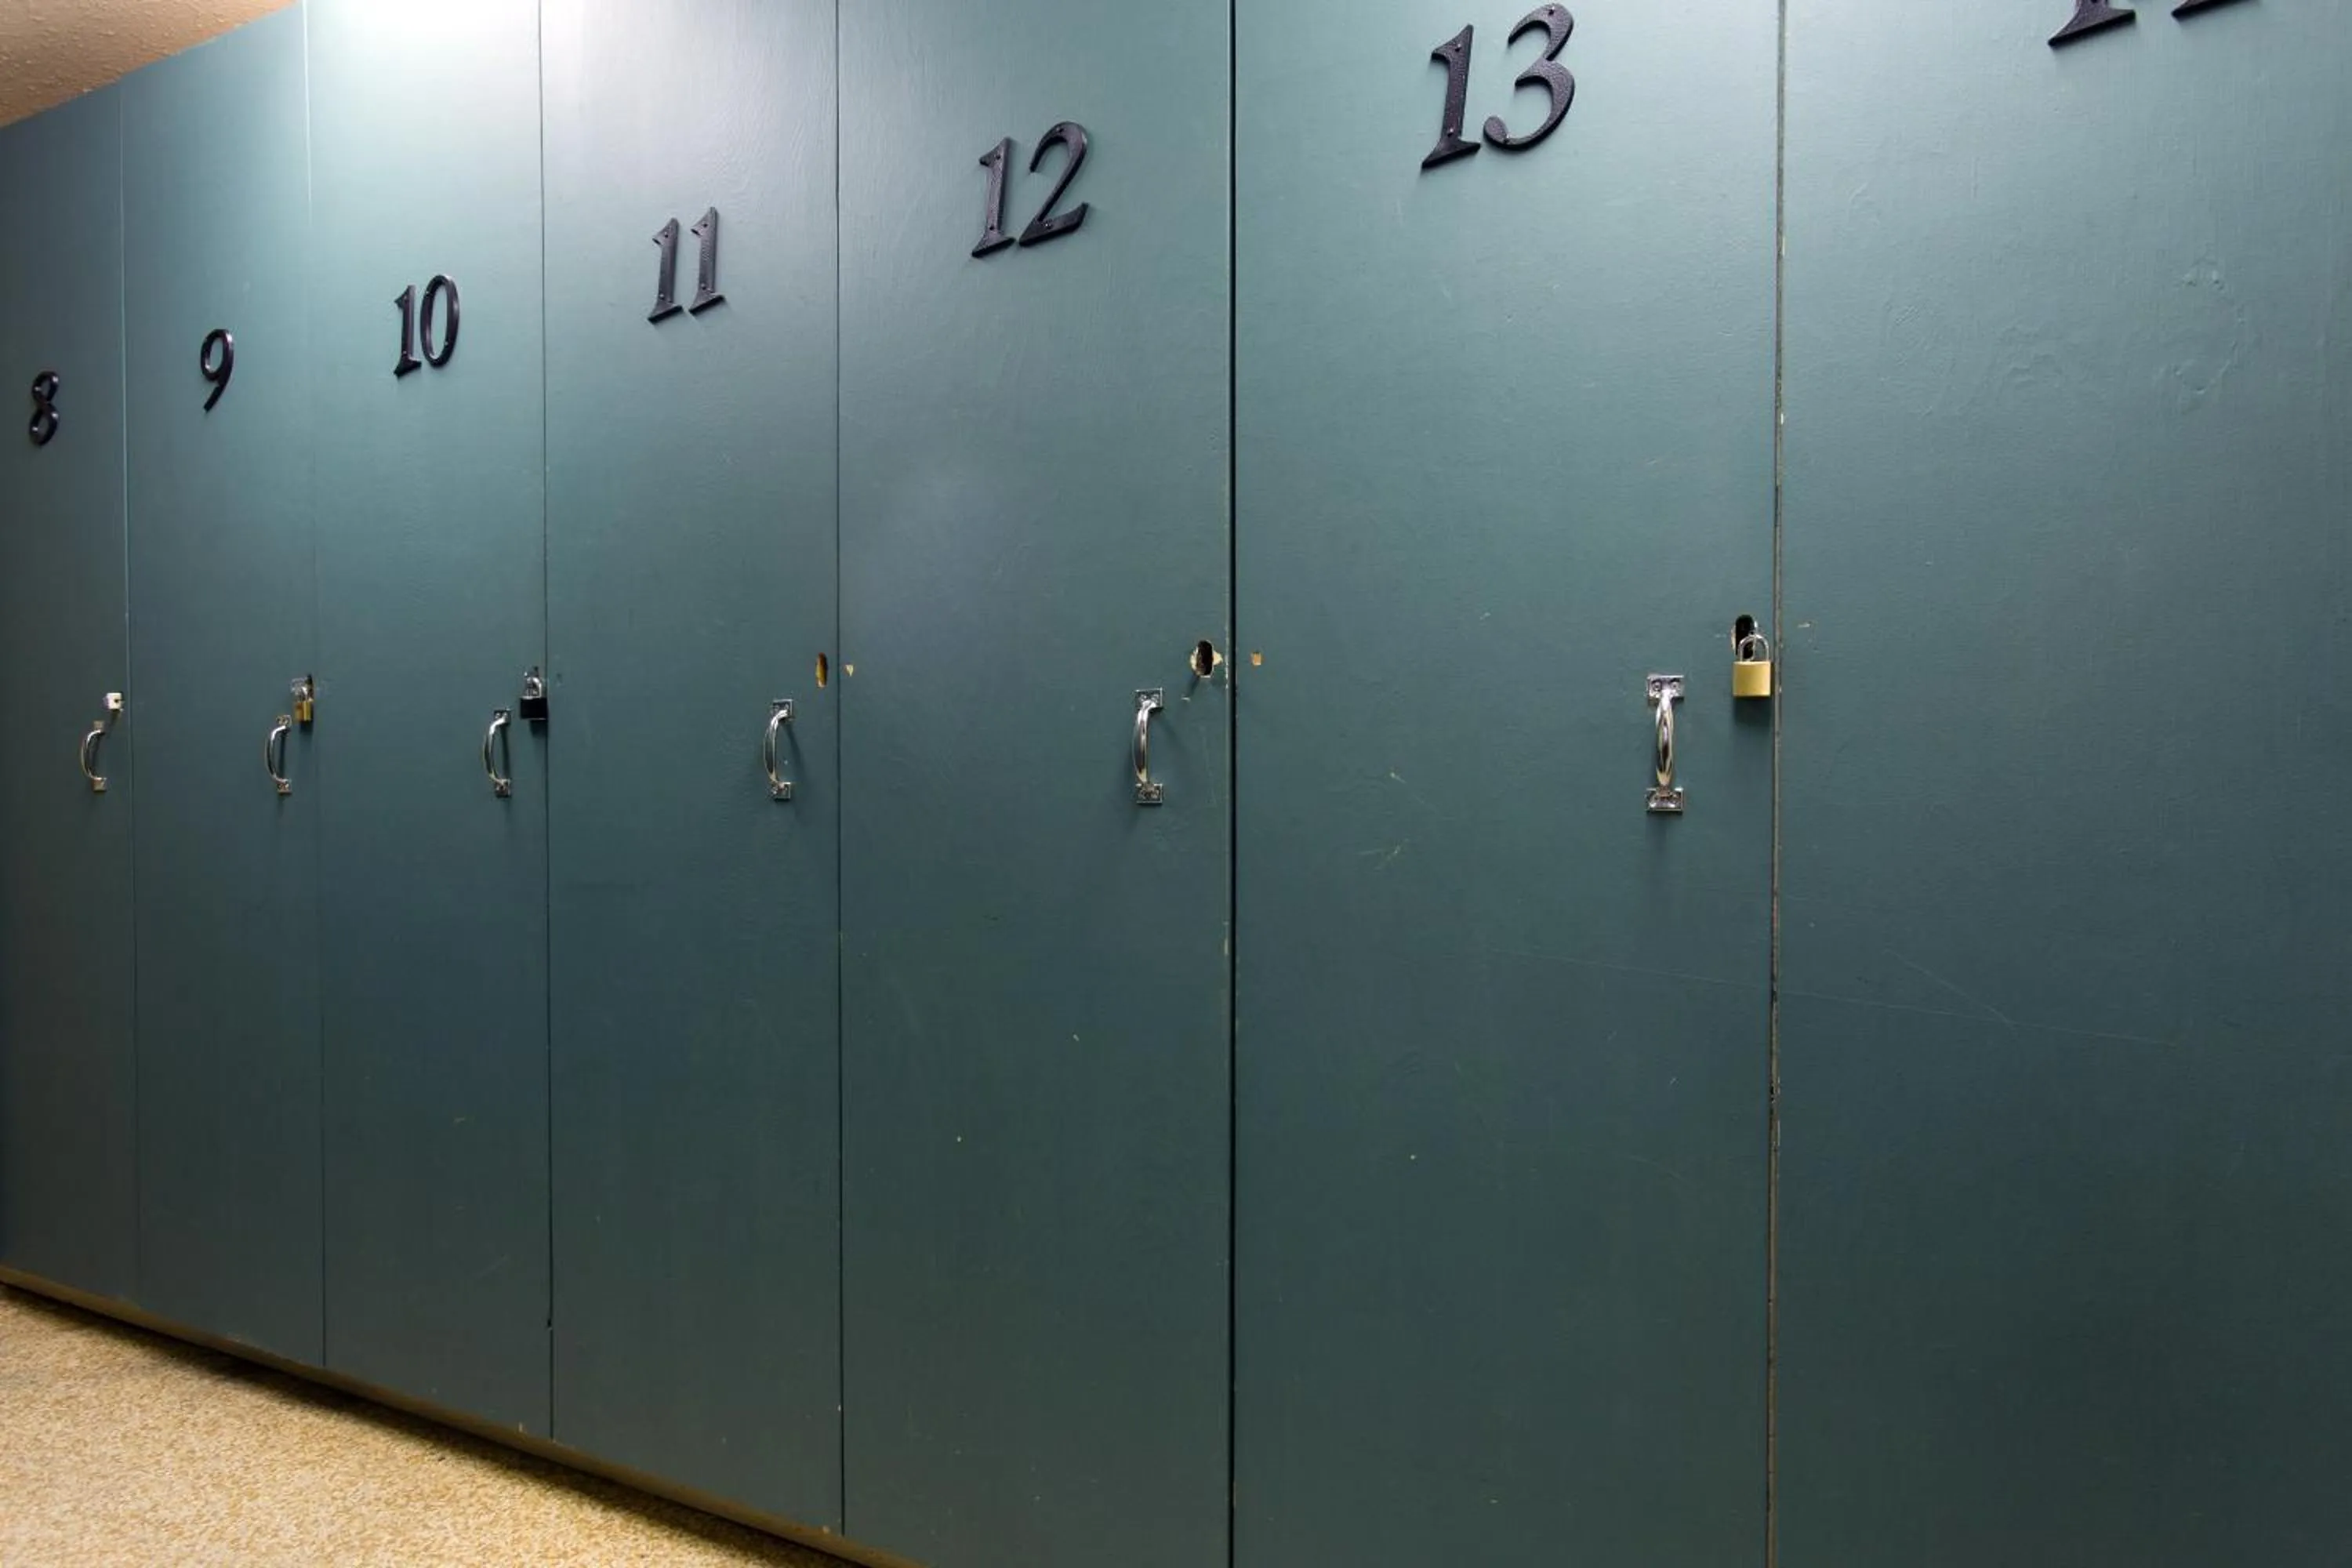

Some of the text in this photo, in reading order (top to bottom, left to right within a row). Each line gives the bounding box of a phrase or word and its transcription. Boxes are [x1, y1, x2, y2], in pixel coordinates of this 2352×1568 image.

[1421, 3, 1576, 172] 13
[971, 121, 1091, 259] 12
[648, 209, 725, 325] 11
[200, 328, 234, 414] 9
[394, 274, 460, 377] 10
[28, 371, 60, 445] 8
